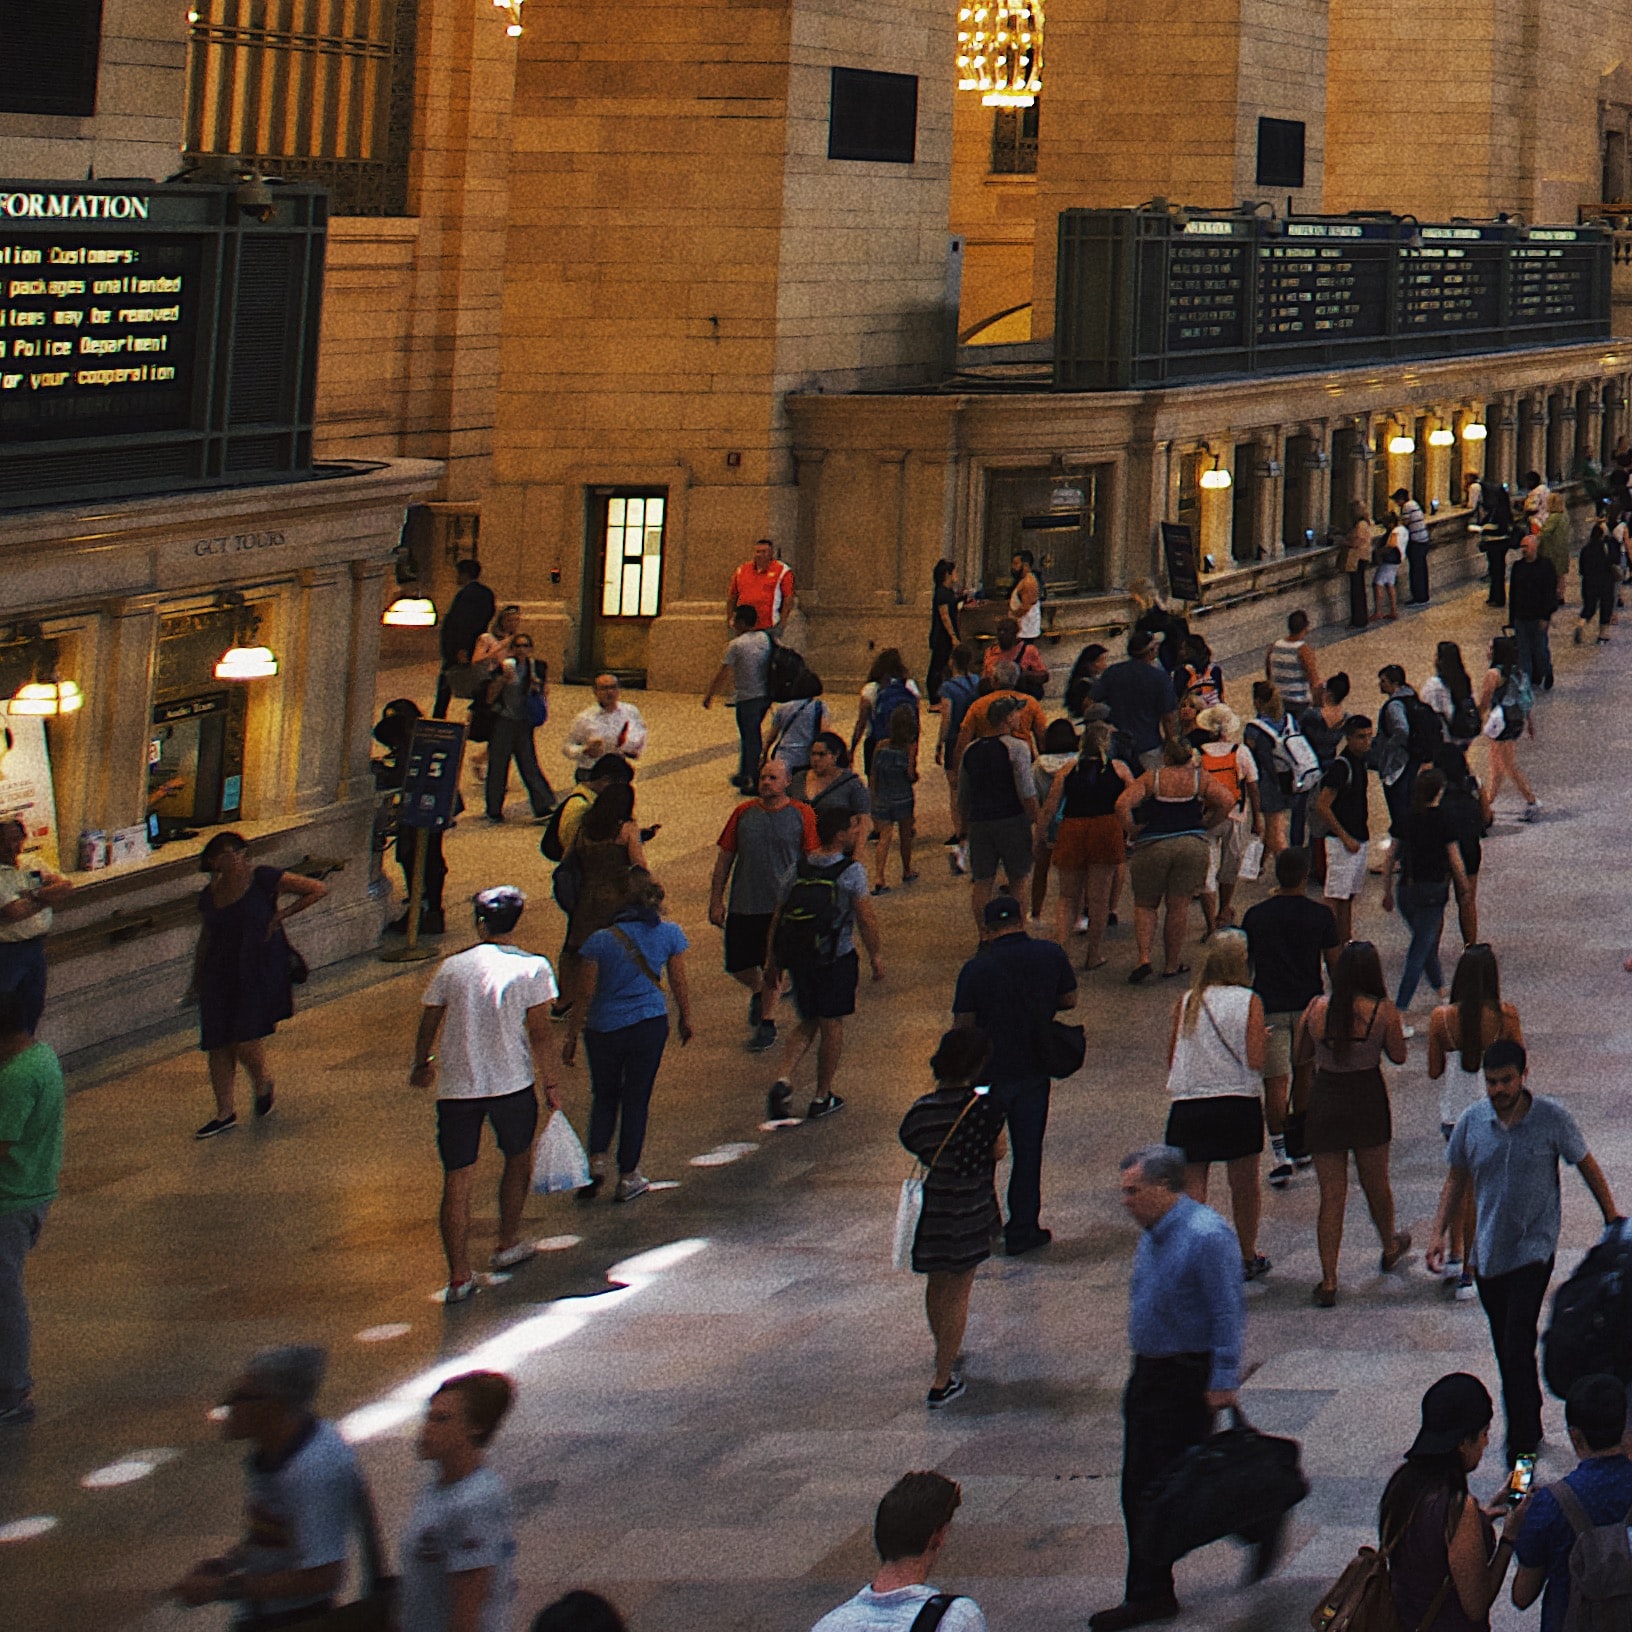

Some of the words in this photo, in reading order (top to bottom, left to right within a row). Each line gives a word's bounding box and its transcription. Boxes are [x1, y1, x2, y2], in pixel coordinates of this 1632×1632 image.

[9, 280, 86, 297] packages
[92, 276, 182, 295] unattended
[53, 310, 84, 328] may
[118, 305, 180, 323] removed
[13, 339, 73, 357] Police
[80, 334, 168, 358] Department
[30, 371, 70, 390] your
[76, 364, 175, 386] cooperation
